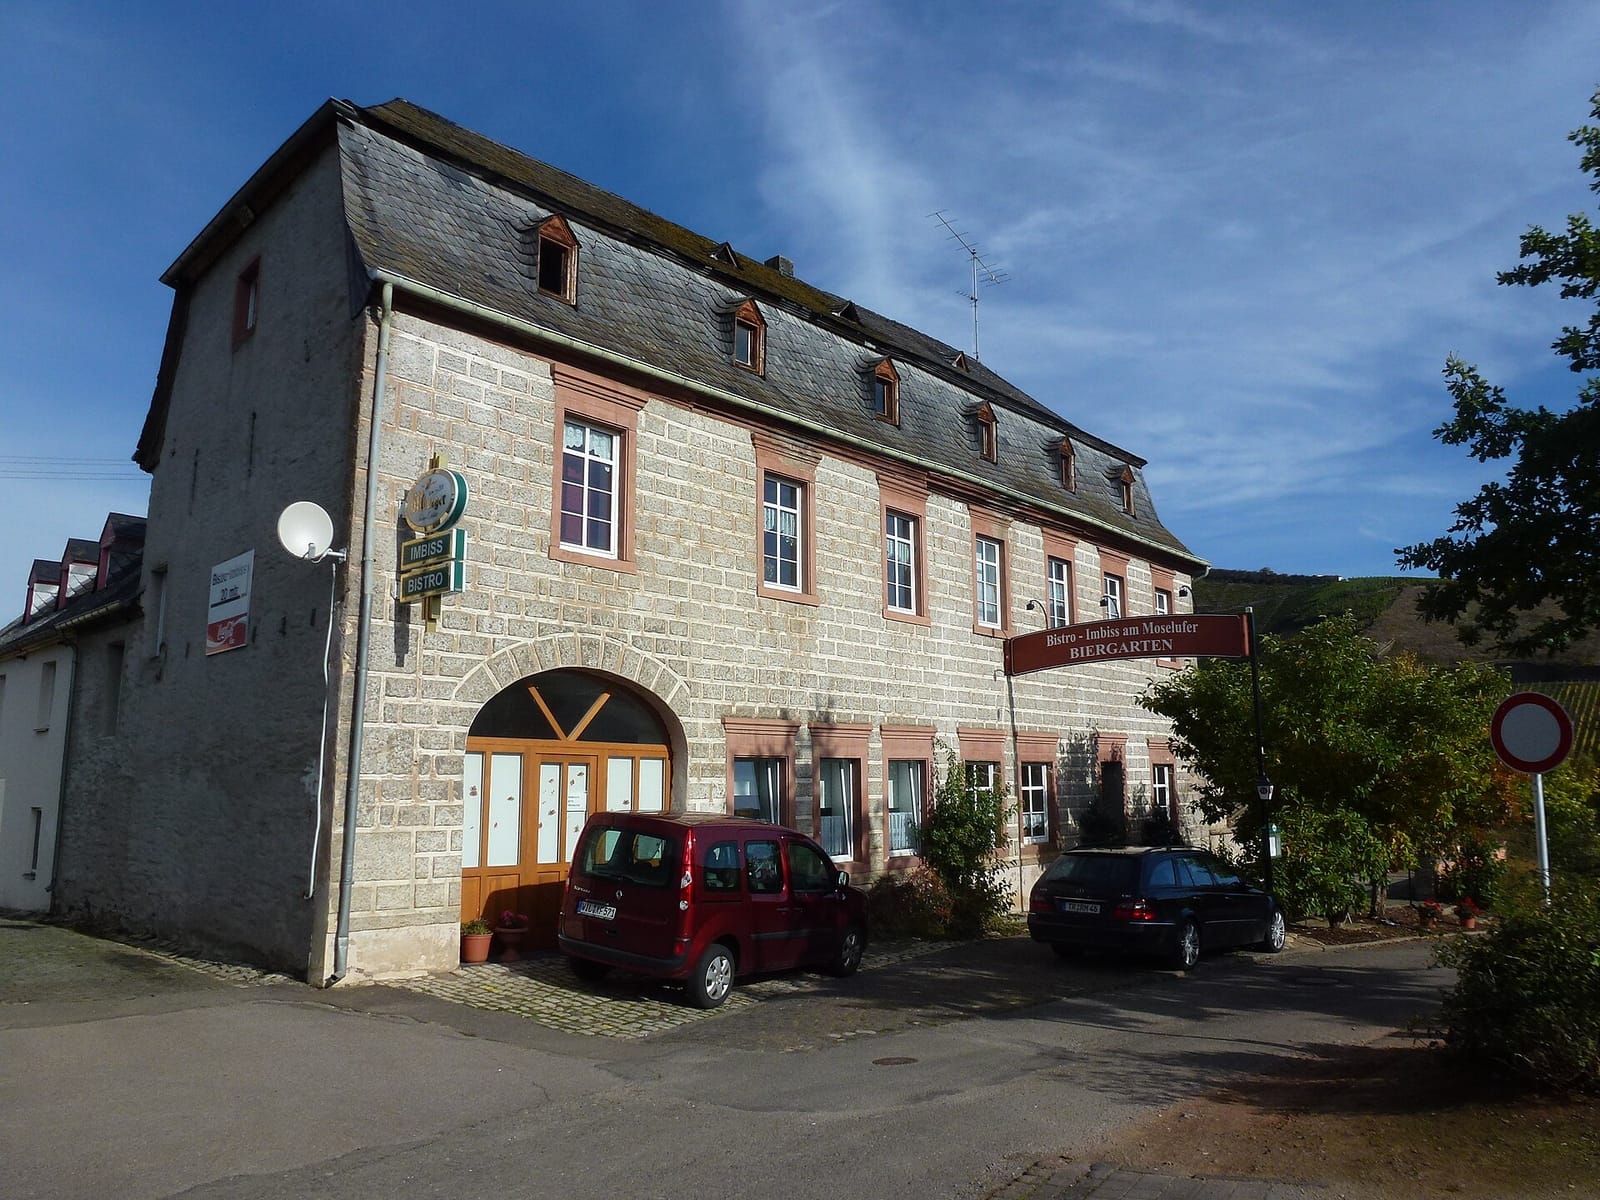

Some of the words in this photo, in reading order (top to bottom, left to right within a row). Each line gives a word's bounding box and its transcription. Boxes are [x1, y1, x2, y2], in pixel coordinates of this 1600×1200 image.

[410, 539, 443, 561] IMBISS
[407, 571, 443, 593] BISTRO
[1046, 633, 1076, 647] Bistro
[1085, 626, 1120, 640] Imbiss
[1122, 626, 1139, 637] am
[1142, 620, 1198, 635] Moselufer
[1069, 639, 1173, 659] BIERGARTEN
